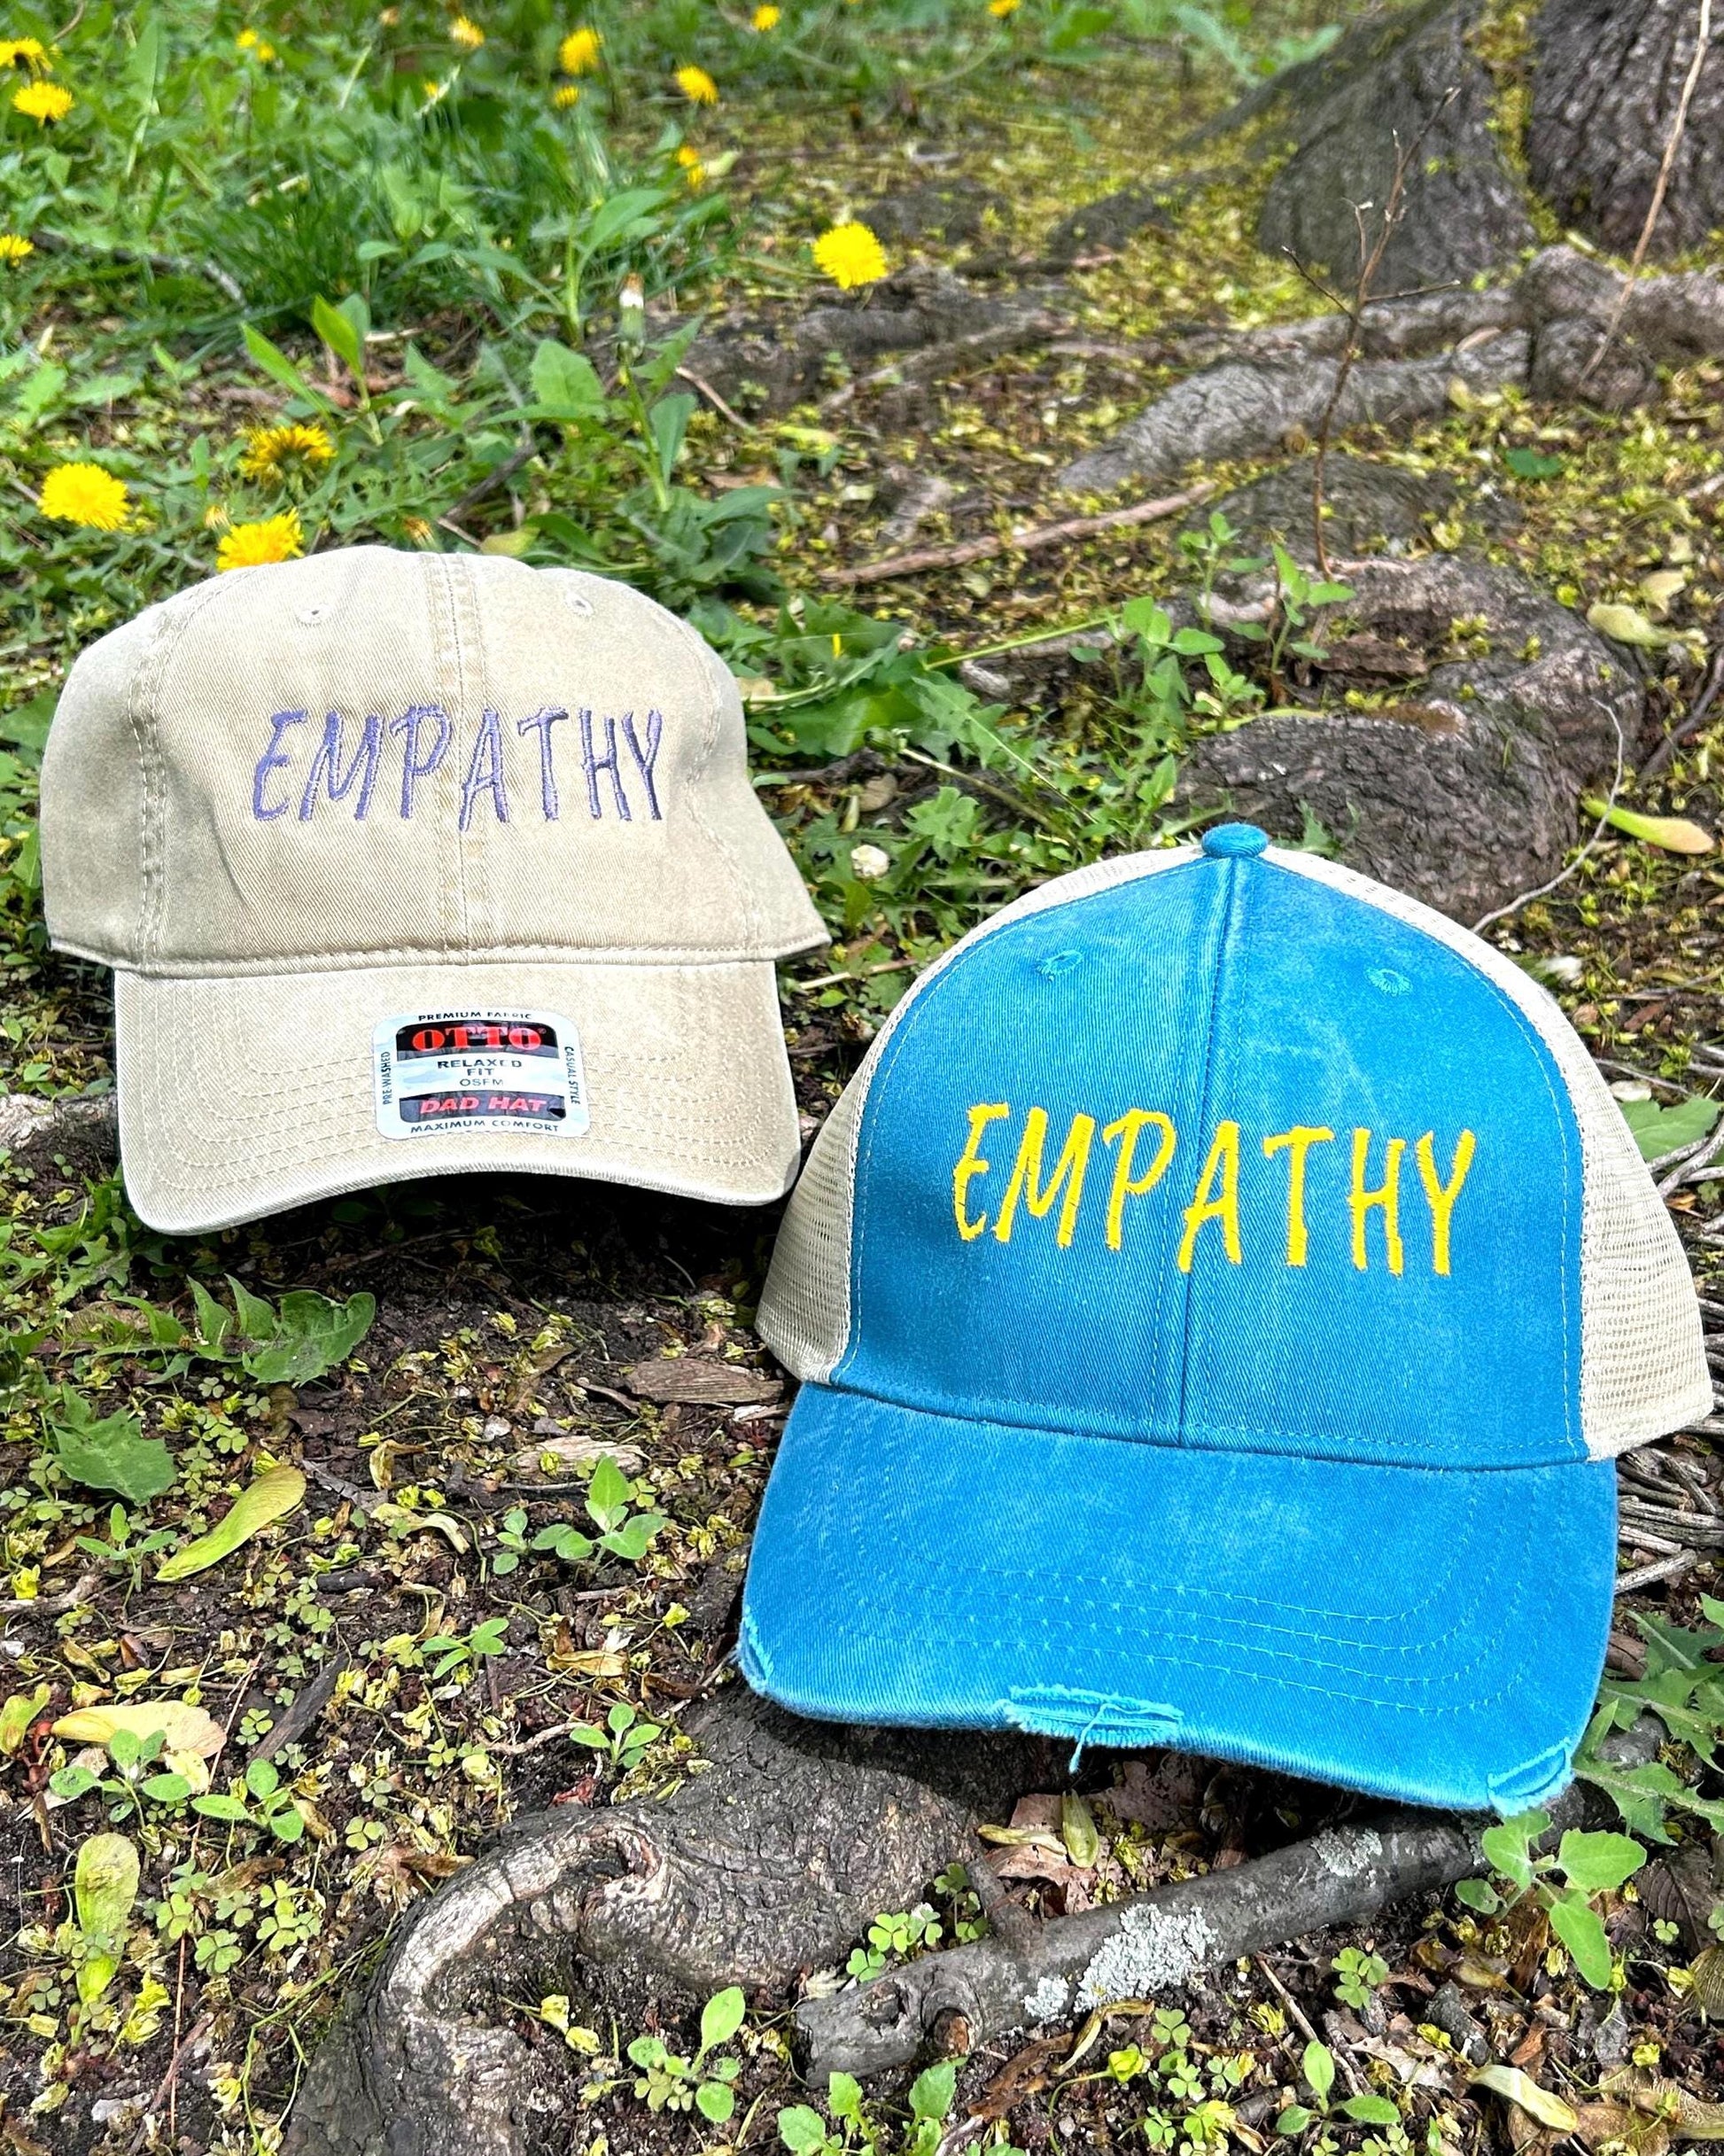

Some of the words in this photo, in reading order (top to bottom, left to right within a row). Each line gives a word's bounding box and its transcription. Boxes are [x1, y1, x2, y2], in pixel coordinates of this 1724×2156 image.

[252, 705, 663, 831] EMPATHY
[418, 1011, 481, 1022] PREMIUM
[438, 1059, 522, 1069] RELAXED
[381, 1051, 392, 1105] PRE-WASHED
[460, 1078, 503, 1086] OSFM
[564, 1046, 576, 1080] CASUAL
[570, 1080, 581, 1104] STYLE
[420, 1097, 479, 1114] DAD
[488, 1097, 547, 1112] HAT
[410, 1120, 485, 1133] MAXIMUM
[492, 1120, 559, 1132] COMFORT
[952, 1102, 1476, 1276] EMPATHY
